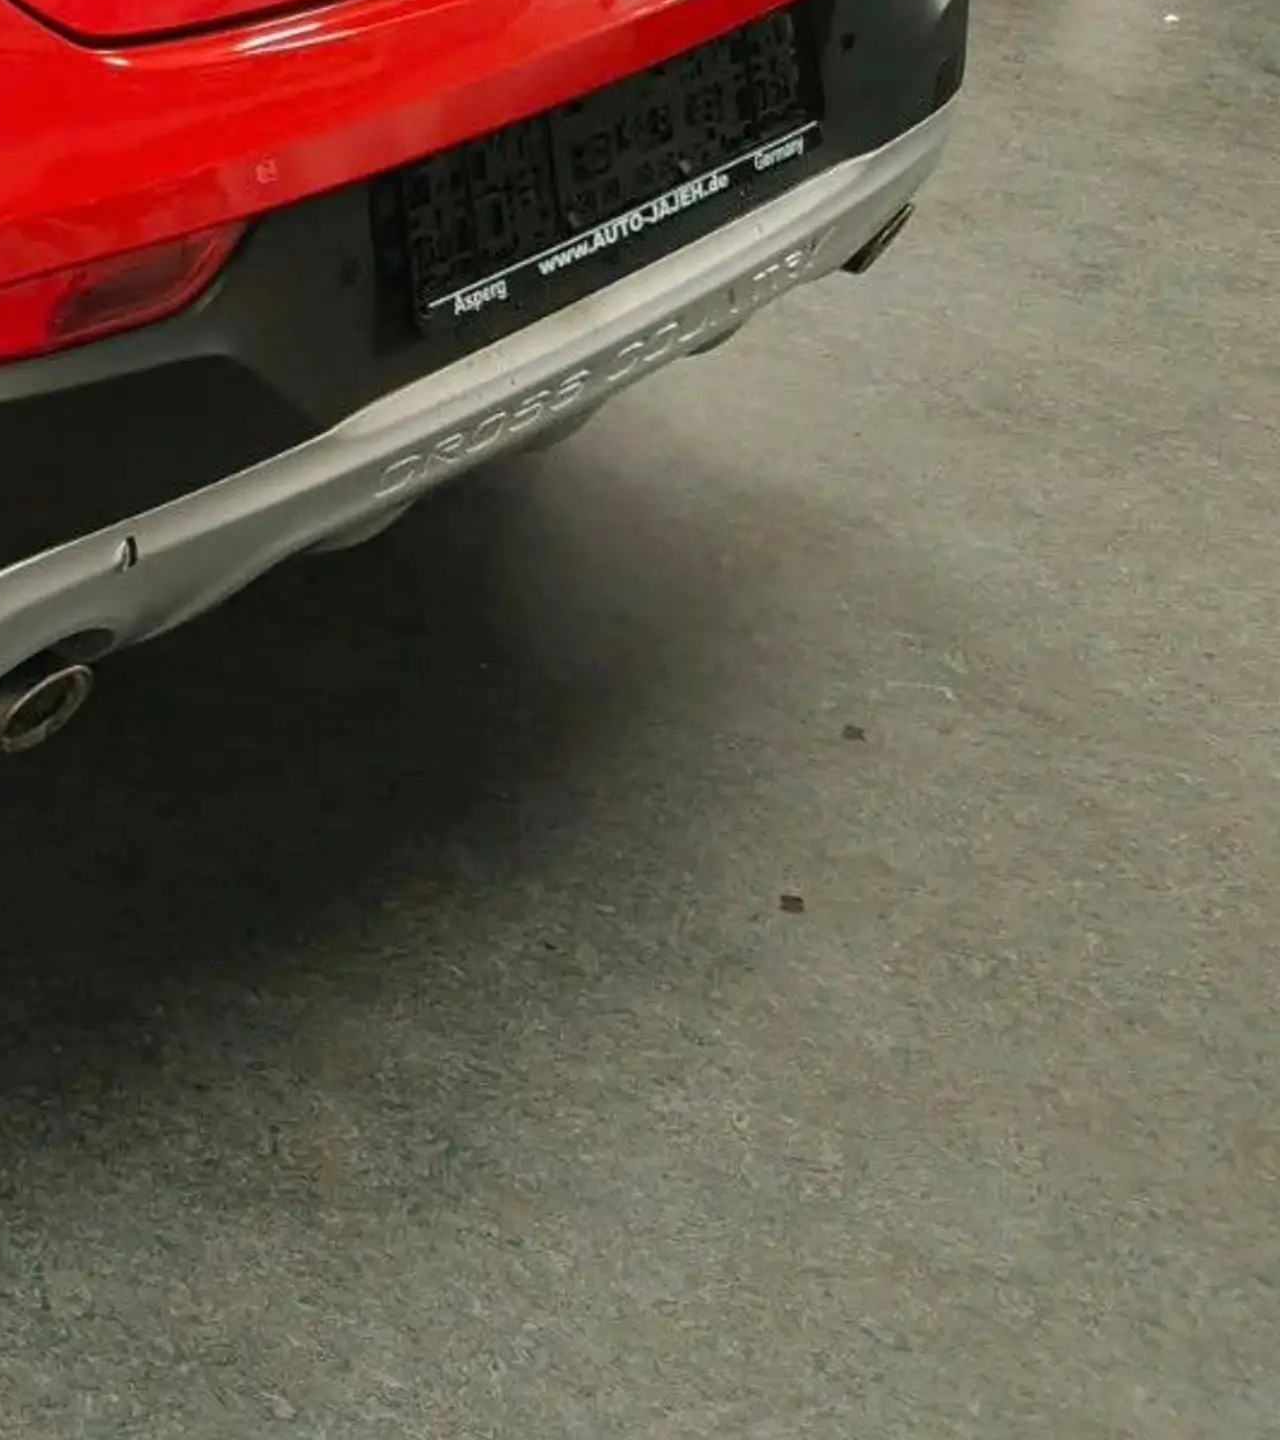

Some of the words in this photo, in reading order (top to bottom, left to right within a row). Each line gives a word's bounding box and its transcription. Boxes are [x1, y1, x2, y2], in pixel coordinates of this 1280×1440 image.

[453, 279, 508, 316] Asperg
[538, 173, 730, 276] www.AUTO-JAJEH.de
[373, 369, 592, 498] CROSS
